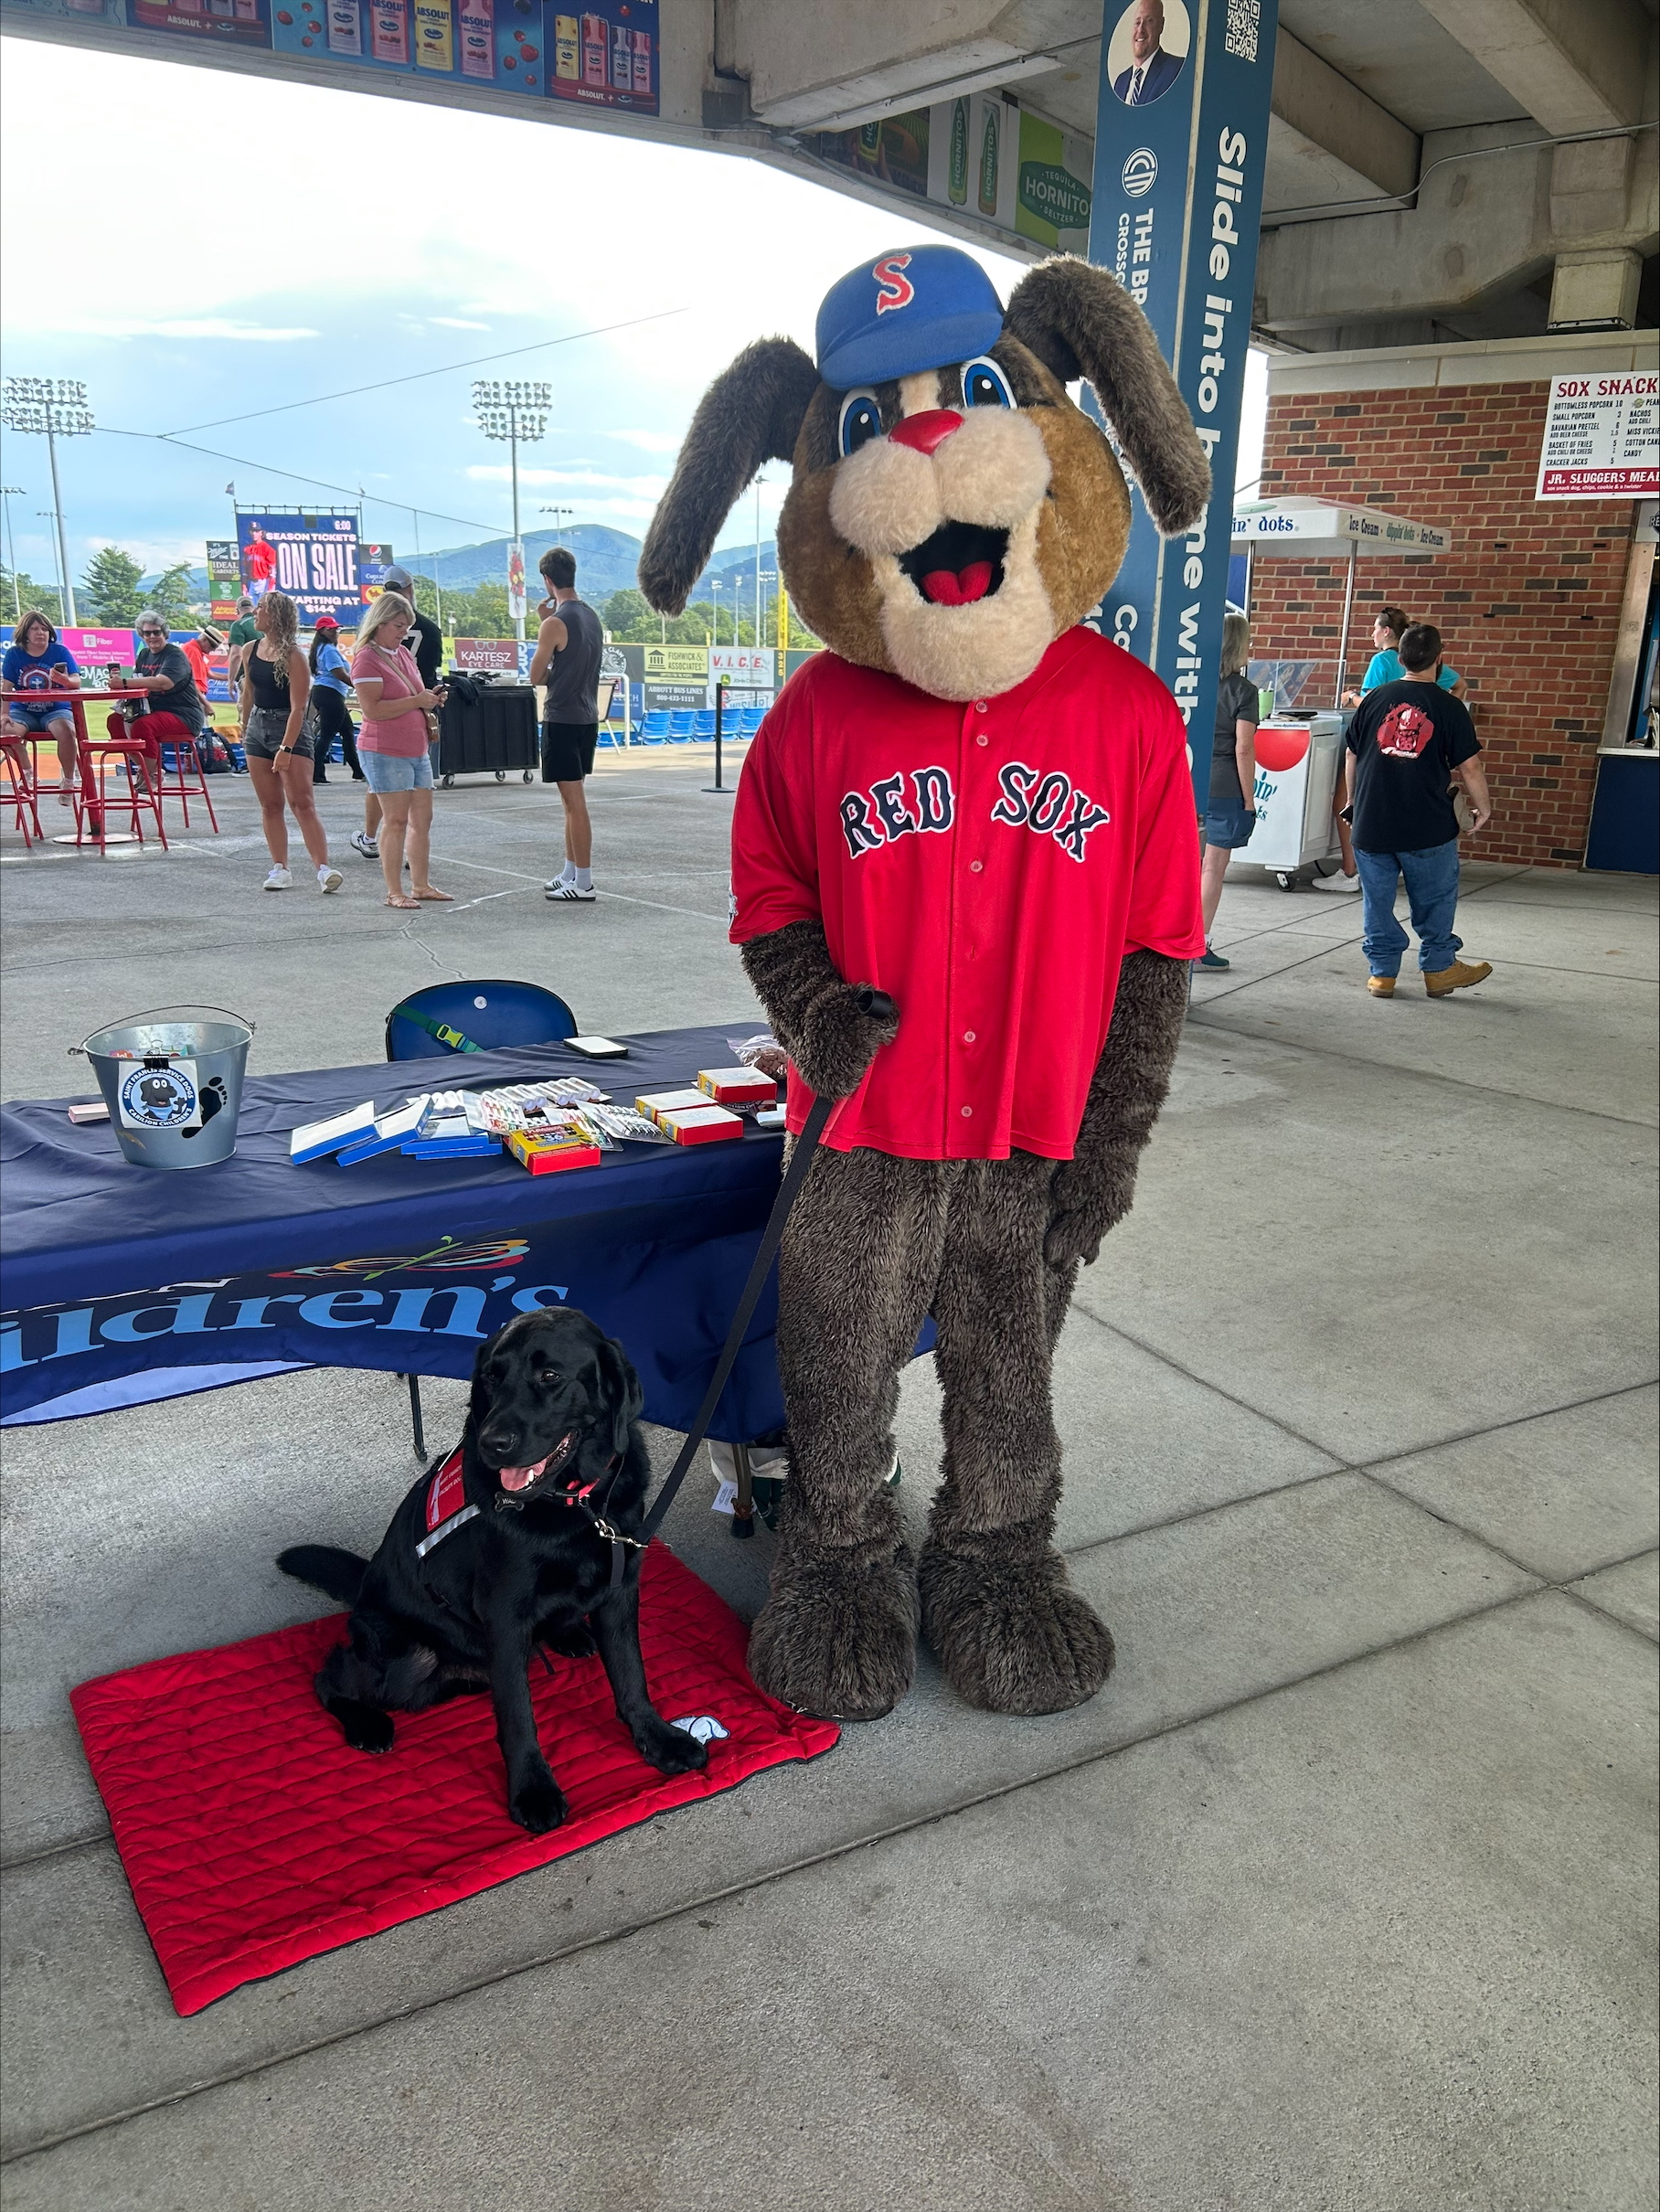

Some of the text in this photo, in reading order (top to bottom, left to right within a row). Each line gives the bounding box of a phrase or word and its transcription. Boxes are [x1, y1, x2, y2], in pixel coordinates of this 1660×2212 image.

[417, 6, 450, 20] ABSOLUT
[461, 15, 492, 28] ABSOLUT
[954, 111, 963, 184] HORNITOS
[985, 127, 994, 196] HORNITOS
[1045, 170, 1077, 191] TEQUILA
[1025, 176, 1091, 215] HORNITO
[1209, 126, 1247, 281] Slide
[1043, 205, 1075, 224] SELTZER
[1133, 207, 1154, 265] THE
[872, 253, 915, 316] S
[1197, 294, 1233, 413] into
[1556, 377, 1659, 397] SOX SNACK
[1554, 401, 1588, 410] BOTTOMLESS
[1589, 399, 1613, 408] POPCORN
[1553, 413, 1570, 421] SMALL
[1571, 412, 1596, 420] POPCORN
[1551, 424, 1577, 432] BAVARIAN
[1546, 458, 1570, 467] CRACKER
[1570, 457, 1589, 466] JACKS
[1547, 473, 1566, 484] JR.
[1570, 472, 1626, 484] SLUGGERS
[1184, 426, 1221, 589] hme
[266, 532, 356, 542] SEASON TICKETS
[1350, 515, 1359, 531] Ice
[1361, 518, 1379, 537] Cream
[1420, 528, 1429, 544] Ice
[1429, 530, 1444, 547] Cream
[278, 542, 358, 591] ON SALE
[343, 597, 360, 606] AT
[461, 651, 511, 662] KARTESZ
[668, 652, 703, 661] FISHWICK &
[668, 662, 702, 670] ASSOCIATES
[839, 761, 1111, 864] RED SOX
[123, 1068, 194, 1100] SAINT FRANCIS SERVICE DOGS
[128, 1108, 193, 1127] CARILION CHILDREN'S
